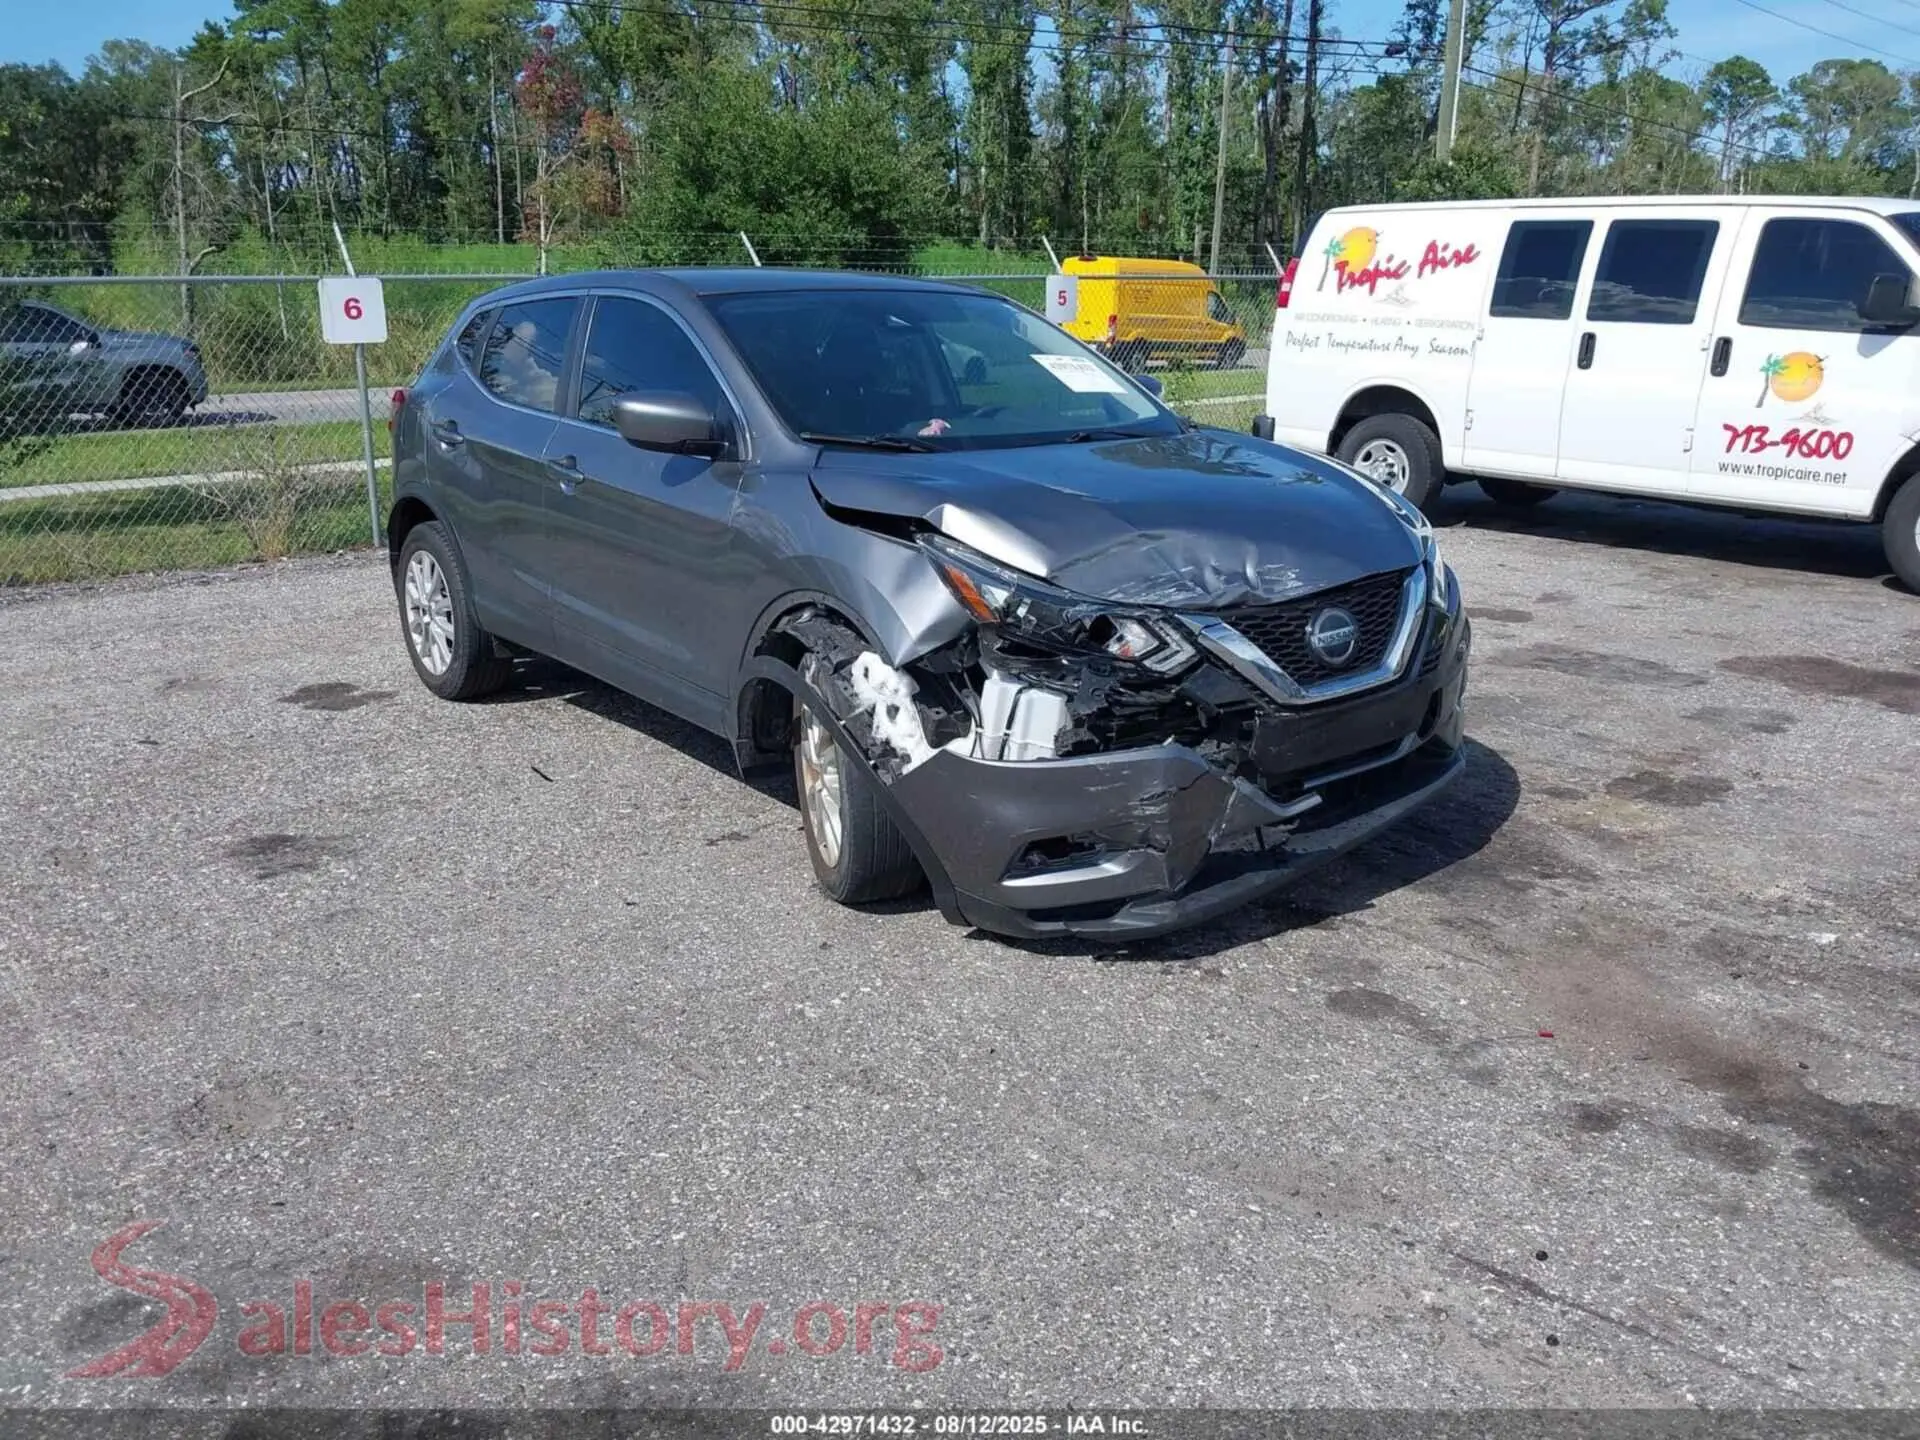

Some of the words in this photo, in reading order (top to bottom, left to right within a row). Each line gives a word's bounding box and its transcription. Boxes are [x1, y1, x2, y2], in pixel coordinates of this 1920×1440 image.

[1334, 254, 1411, 296] Tropic
[1417, 239, 1480, 279] Aire
[344, 297, 362, 320] 6
[1058, 290, 1067, 306] 5
[1286, 330, 1320, 352] Perfect
[1328, 332, 1391, 353] Temperature
[1393, 336, 1419, 358] Any
[1722, 423, 1854, 460] 713-9600
[1718, 461, 1847, 485] www.tropicaire.net
